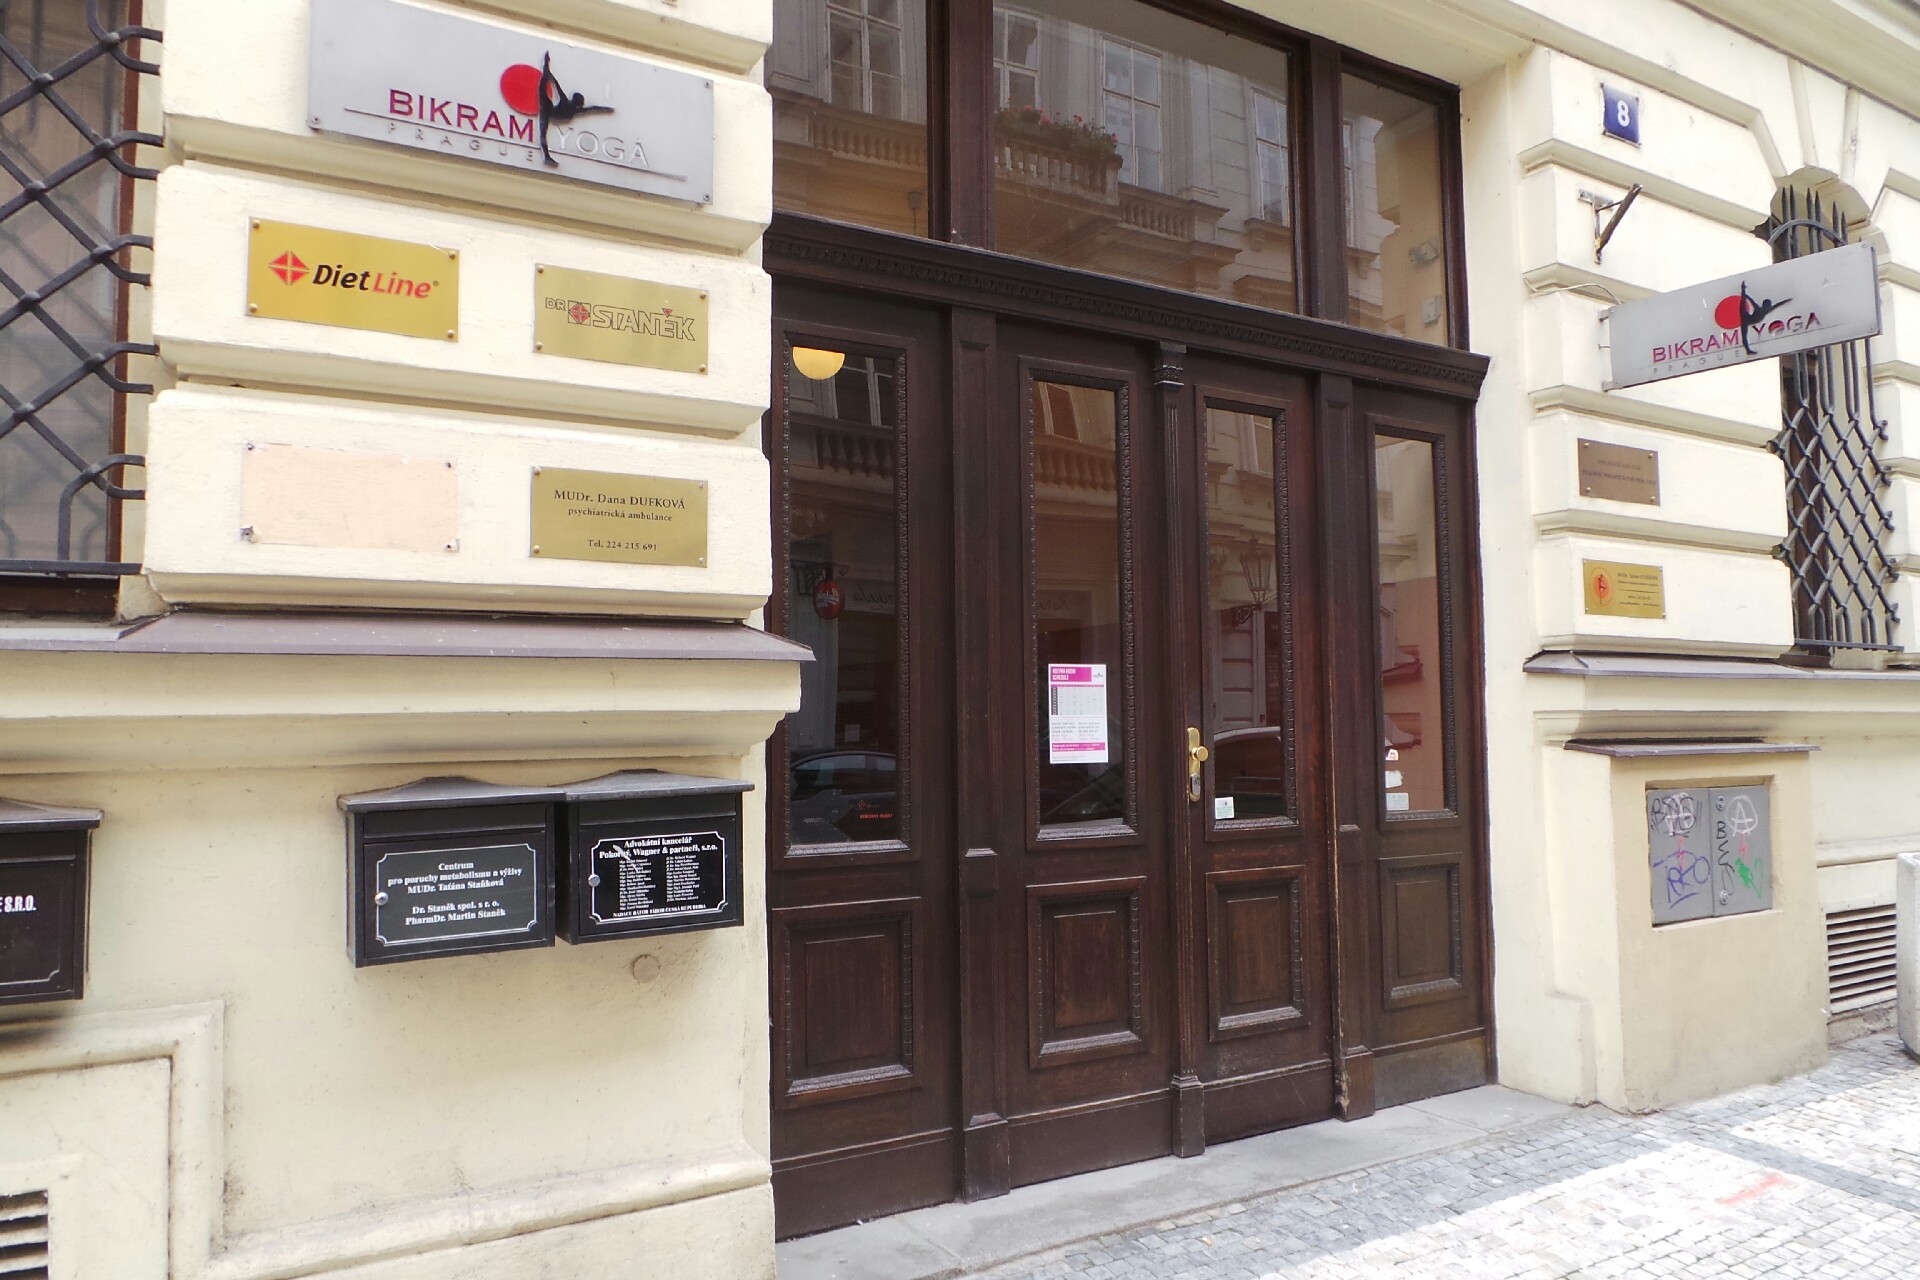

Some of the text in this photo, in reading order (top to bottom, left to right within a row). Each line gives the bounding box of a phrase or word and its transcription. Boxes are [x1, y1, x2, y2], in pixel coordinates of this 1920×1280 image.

[1616, 99, 1630, 128] 8
[388, 88, 650, 168] BIKRAM YOGA
[387, 121, 534, 163] PRAGUE
[544, 297, 567, 312] DR
[1652, 312, 1823, 364] BIKRAM YOGA
[1652, 350, 1740, 375] PRAGUE
[554, 489, 686, 510] MUDr. Dana DUFKOVÁ
[567, 507, 673, 522] psychiatrická ambulance
[587, 539, 658, 551] Tel. 224 215 691
[624, 838, 661, 849] Advokátní
[633, 847, 661, 857] Wagner
[661, 846, 669, 854] &
[701, 842, 718, 851] s.r.o.
[438, 862, 474, 872] Centrum
[387, 878, 403, 887] pro
[404, 874, 439, 887] poruchy
[440, 869, 491, 881] metabolismu
[407, 884, 437, 894] MUDr.
[3, 894, 37, 913] S.R.O.
[412, 905, 426, 914] Dr.
[427, 902, 456, 913] Staněk
[457, 900, 477, 911] spol.
[405, 908, 506, 926] PharmDr. Martin Staněk
